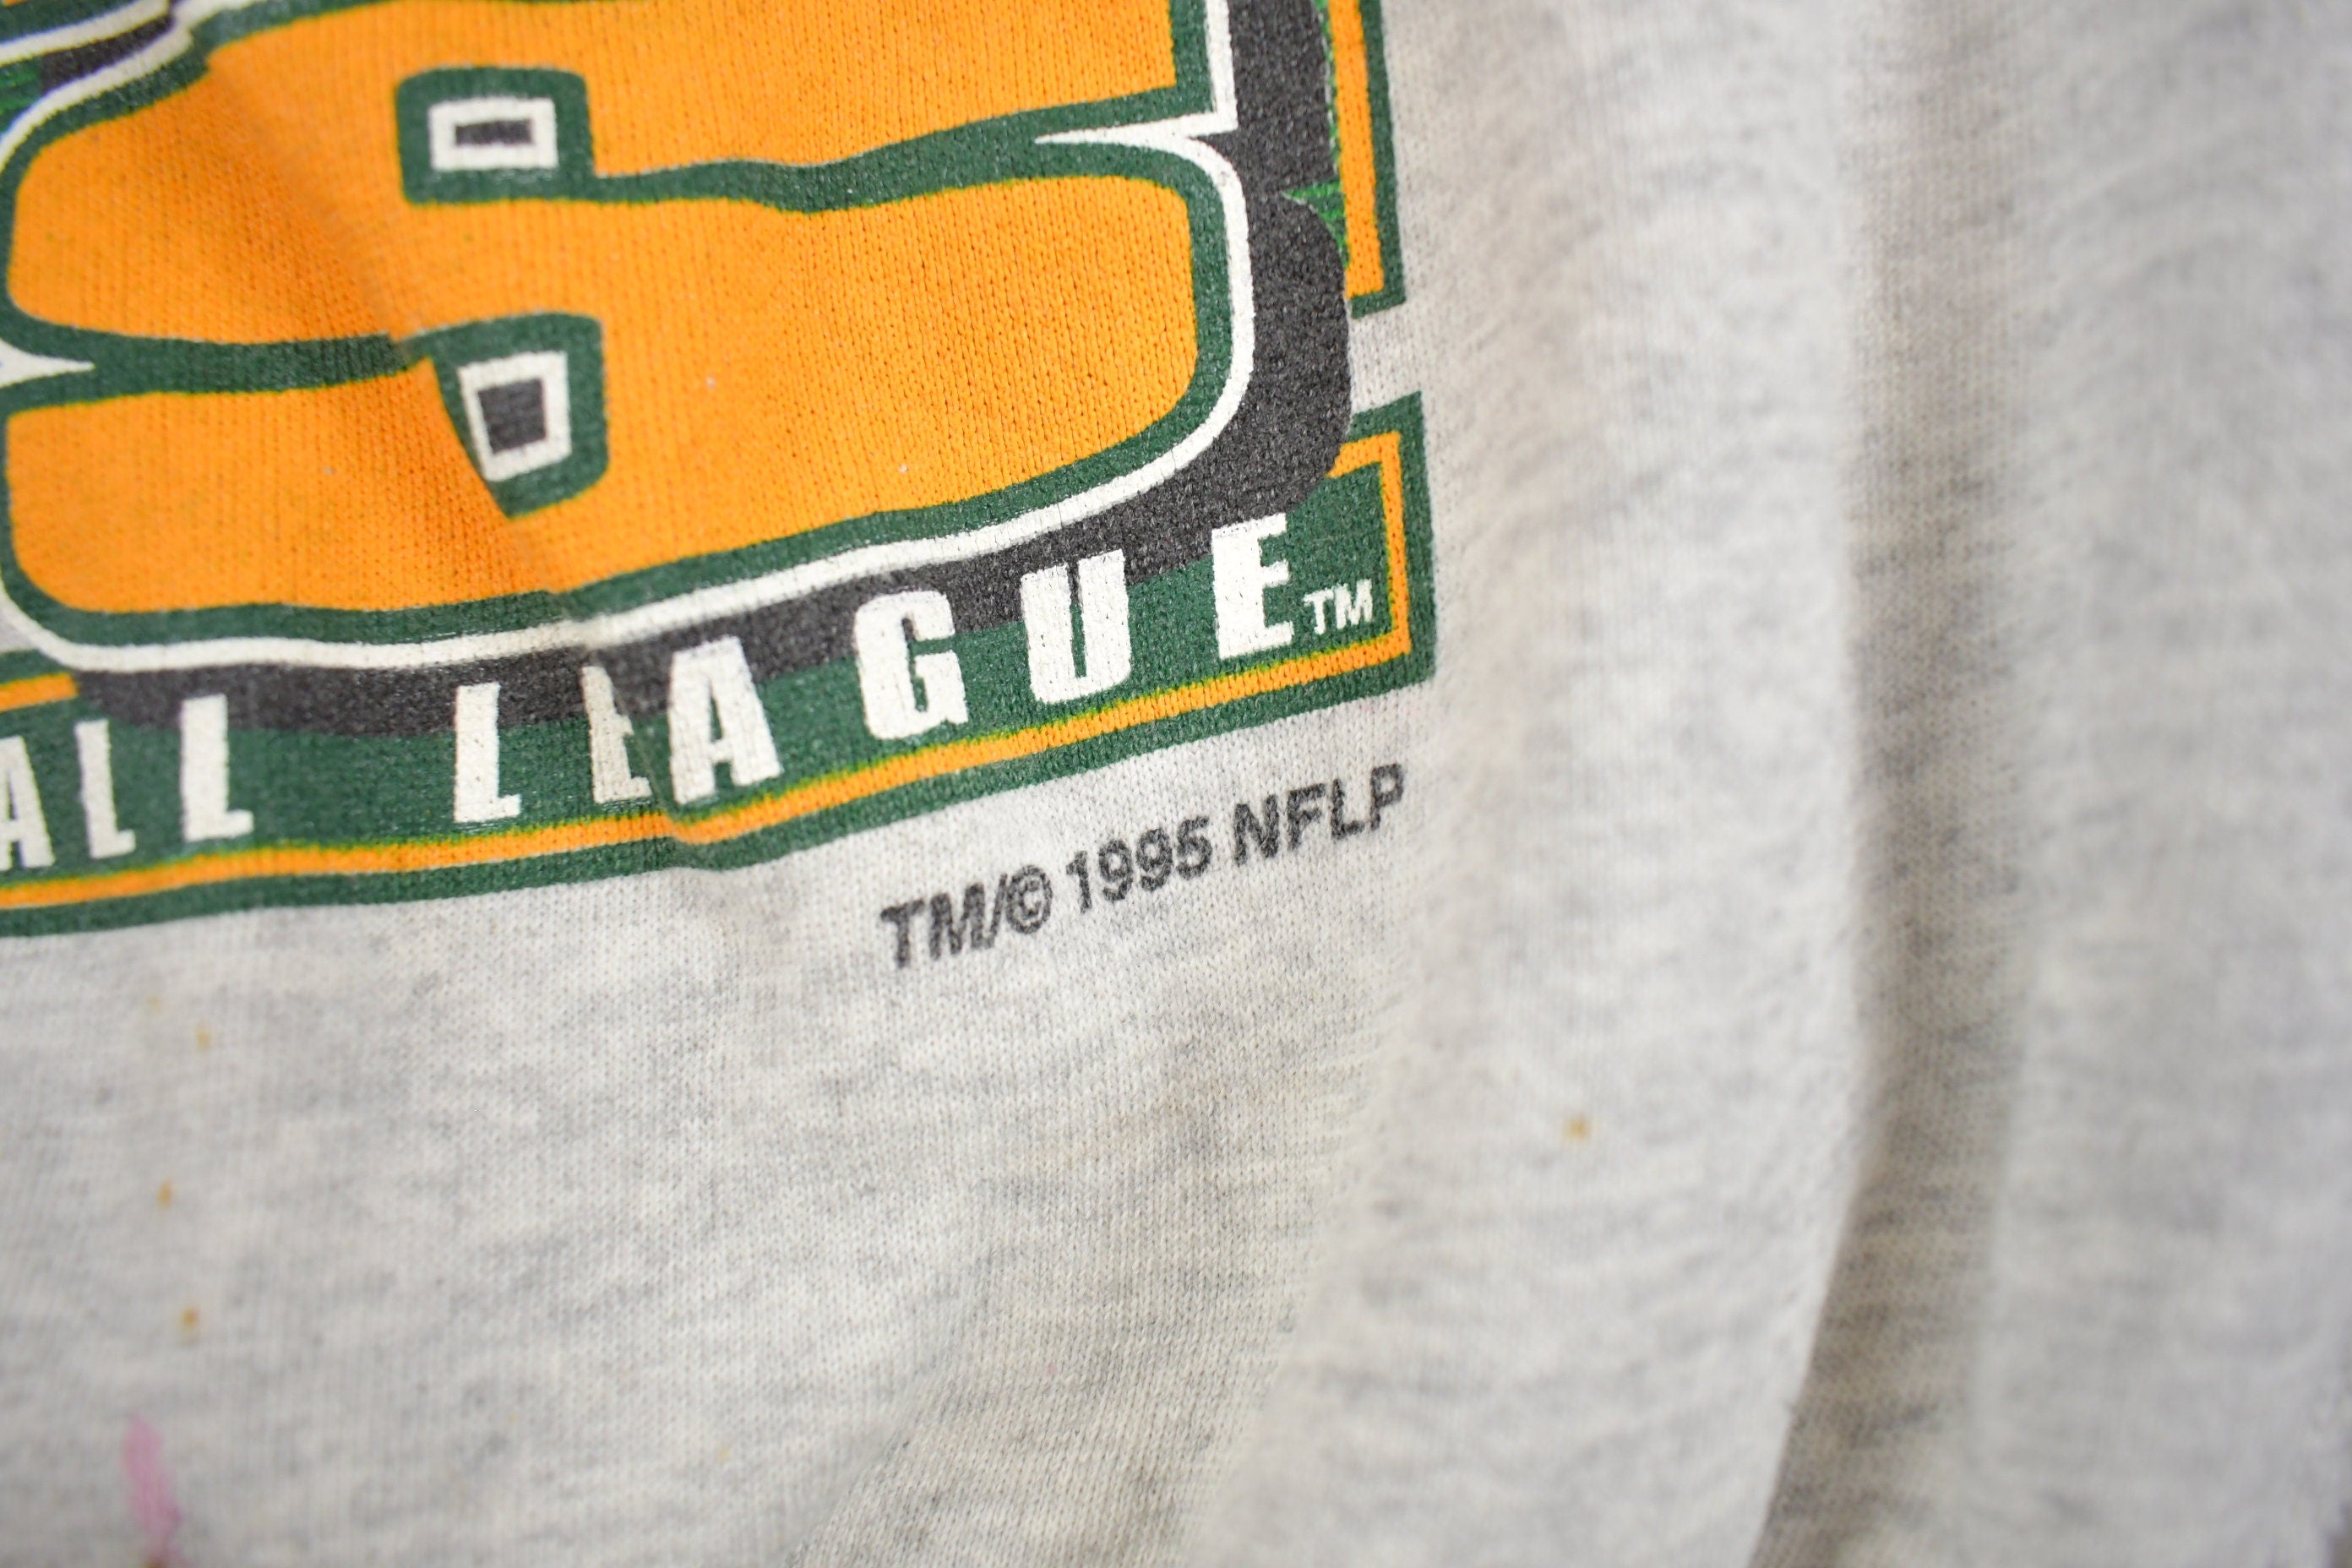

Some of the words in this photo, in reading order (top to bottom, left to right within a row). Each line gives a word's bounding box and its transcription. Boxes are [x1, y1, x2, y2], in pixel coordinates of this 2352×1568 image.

[453, 512, 1295, 824] LEAGUE
[1302, 578, 1374, 635] TM
[1066, 816, 1213, 913] 1995
[1233, 763, 1406, 866] NFLP
